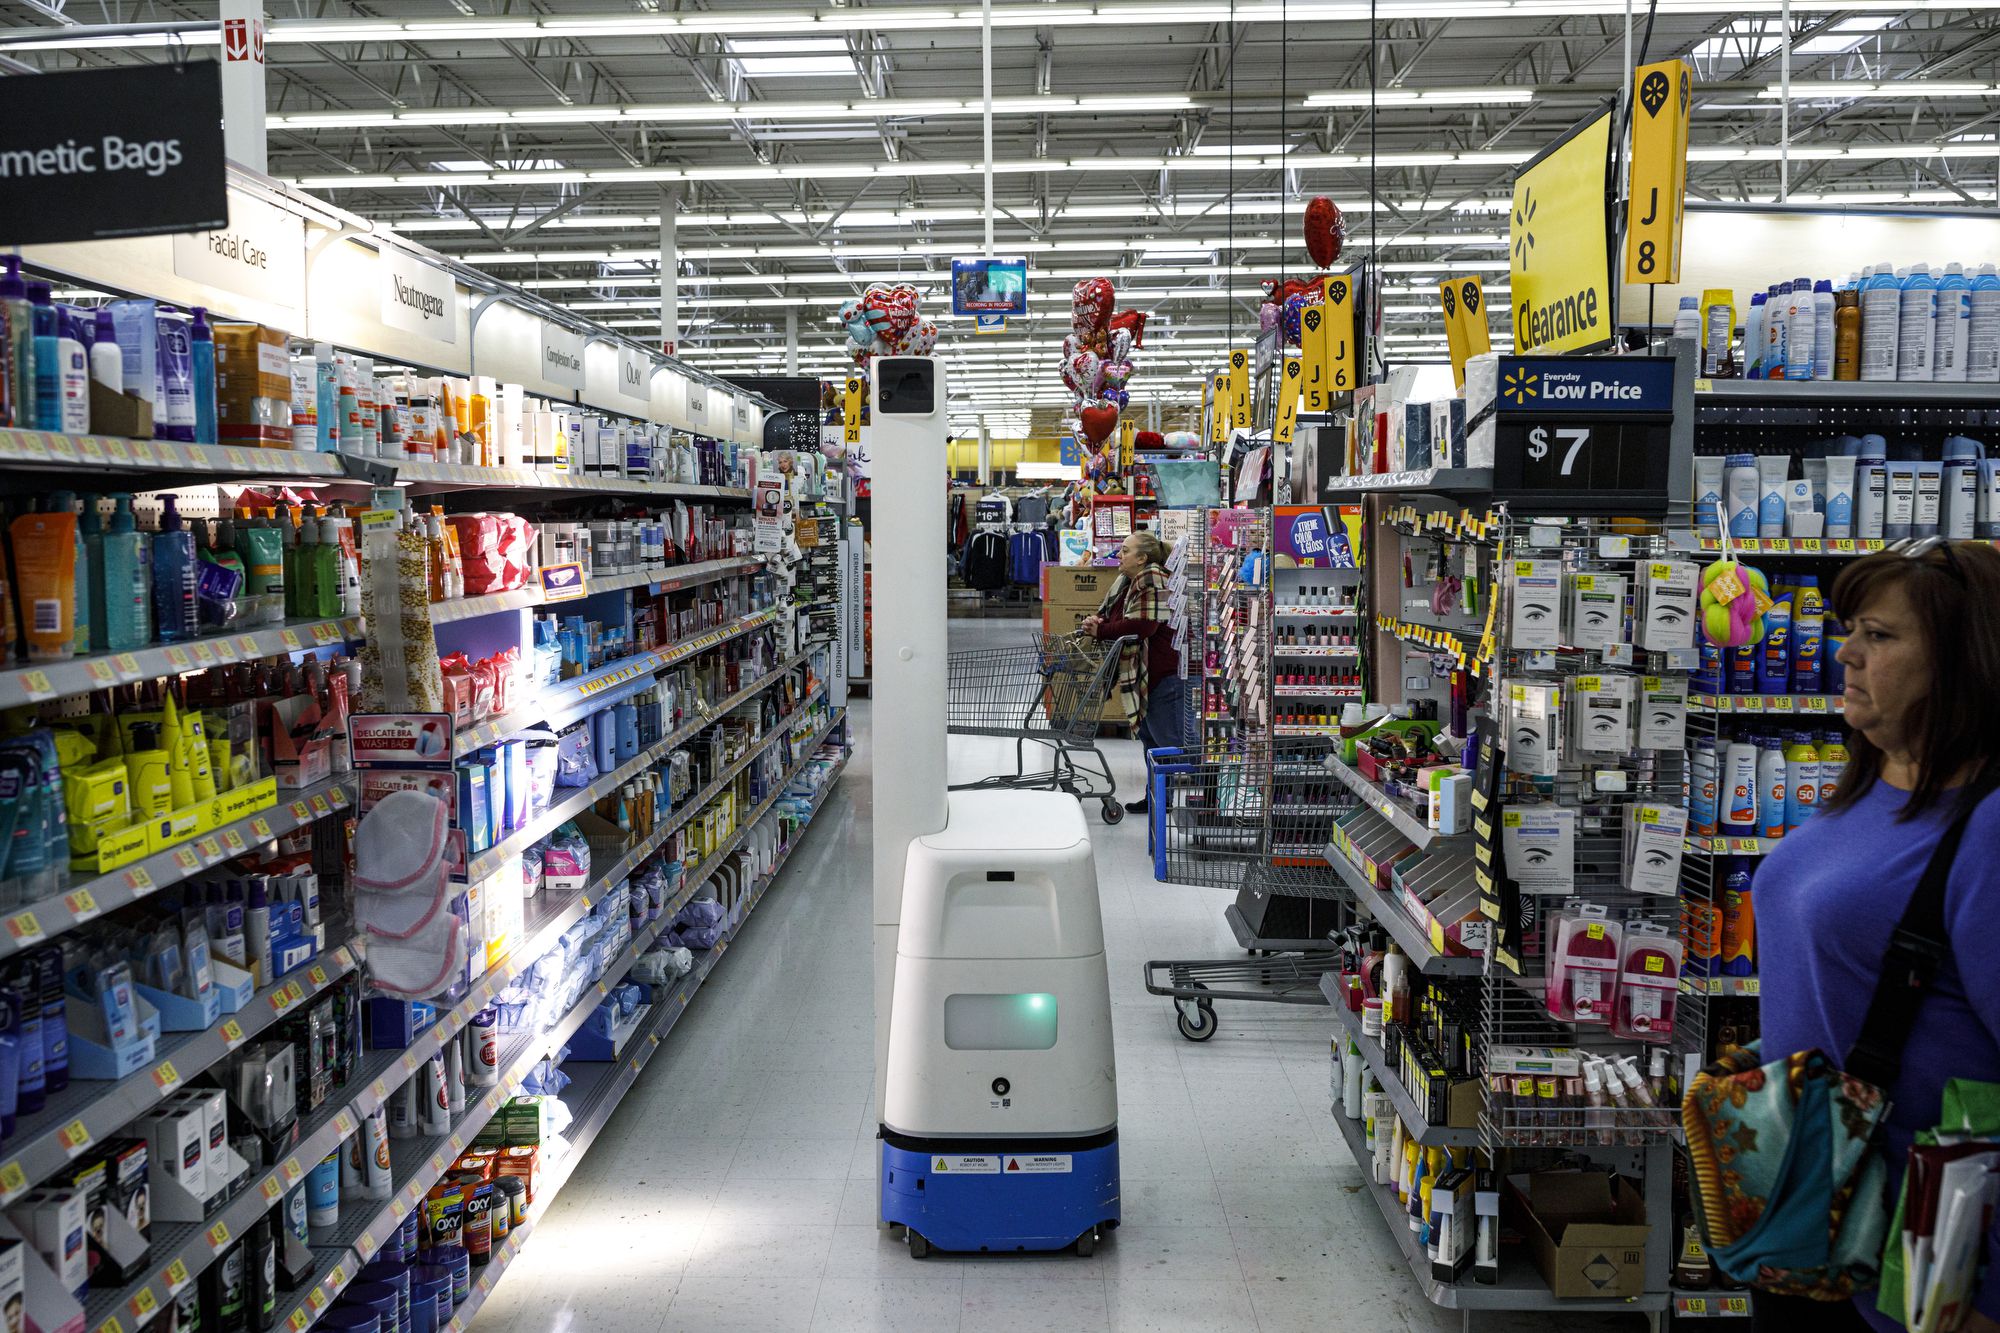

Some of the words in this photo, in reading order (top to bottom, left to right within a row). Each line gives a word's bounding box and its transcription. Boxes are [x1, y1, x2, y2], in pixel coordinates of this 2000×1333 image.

[103, 136, 182, 177] Bags
[1641, 187, 1658, 225] J
[208, 230, 240, 260] Facial
[242, 239, 267, 270] Care
[1637, 240, 1656, 275] 8
[393, 274, 444, 320] Neutrogena
[1518, 287, 1598, 350] Clearance
[546, 345, 570, 368] Complexion
[1335, 340, 1345, 361] J
[1311, 364, 1320, 384] J
[1335, 368, 1346, 387] 6
[1543, 372, 1581, 382] Everyday
[1543, 381, 1587, 399] Low
[1590, 380, 1643, 400] Price
[1238, 393, 1245, 407] J
[1311, 390, 1321, 407] 5
[1216, 412, 1221, 424] J
[1238, 412, 1245, 425] 3
[1283, 405, 1292, 420] J
[849, 414, 856, 426] J
[847, 429, 858, 440] 21
[1215, 428, 1221, 439] 2
[1280, 425, 1289, 439] 4
[1796, 486, 1807, 494] 70
[1836, 497, 1848, 505] 55
[1741, 512, 1753, 520] 70
[1297, 519, 1319, 532] XTREME
[1294, 531, 1313, 545] COLOR
[1743, 539, 1756, 549] 5.97
[1773, 539, 1786, 549] 5.97
[1804, 540, 1817, 549] 4.48
[1838, 539, 1850, 549] 4.47
[1300, 541, 1306, 555] &
[1305, 539, 1324, 553] GLOSS
[357, 730, 396, 738] DELICATE
[397, 730, 413, 738] BRA
[361, 738, 389, 748] WASH
[390, 738, 410, 748] BAG
[366, 781, 402, 791] DELICATE
[402, 783, 418, 791] BRA
[1774, 787, 1785, 797] 70
[1798, 790, 1813, 799] 50
[1743, 840, 1756, 849] 4.98
[467, 1196, 491, 1213] OXY
[436, 1215, 460, 1231] OXY
[1690, 1245, 1700, 1253] 15
